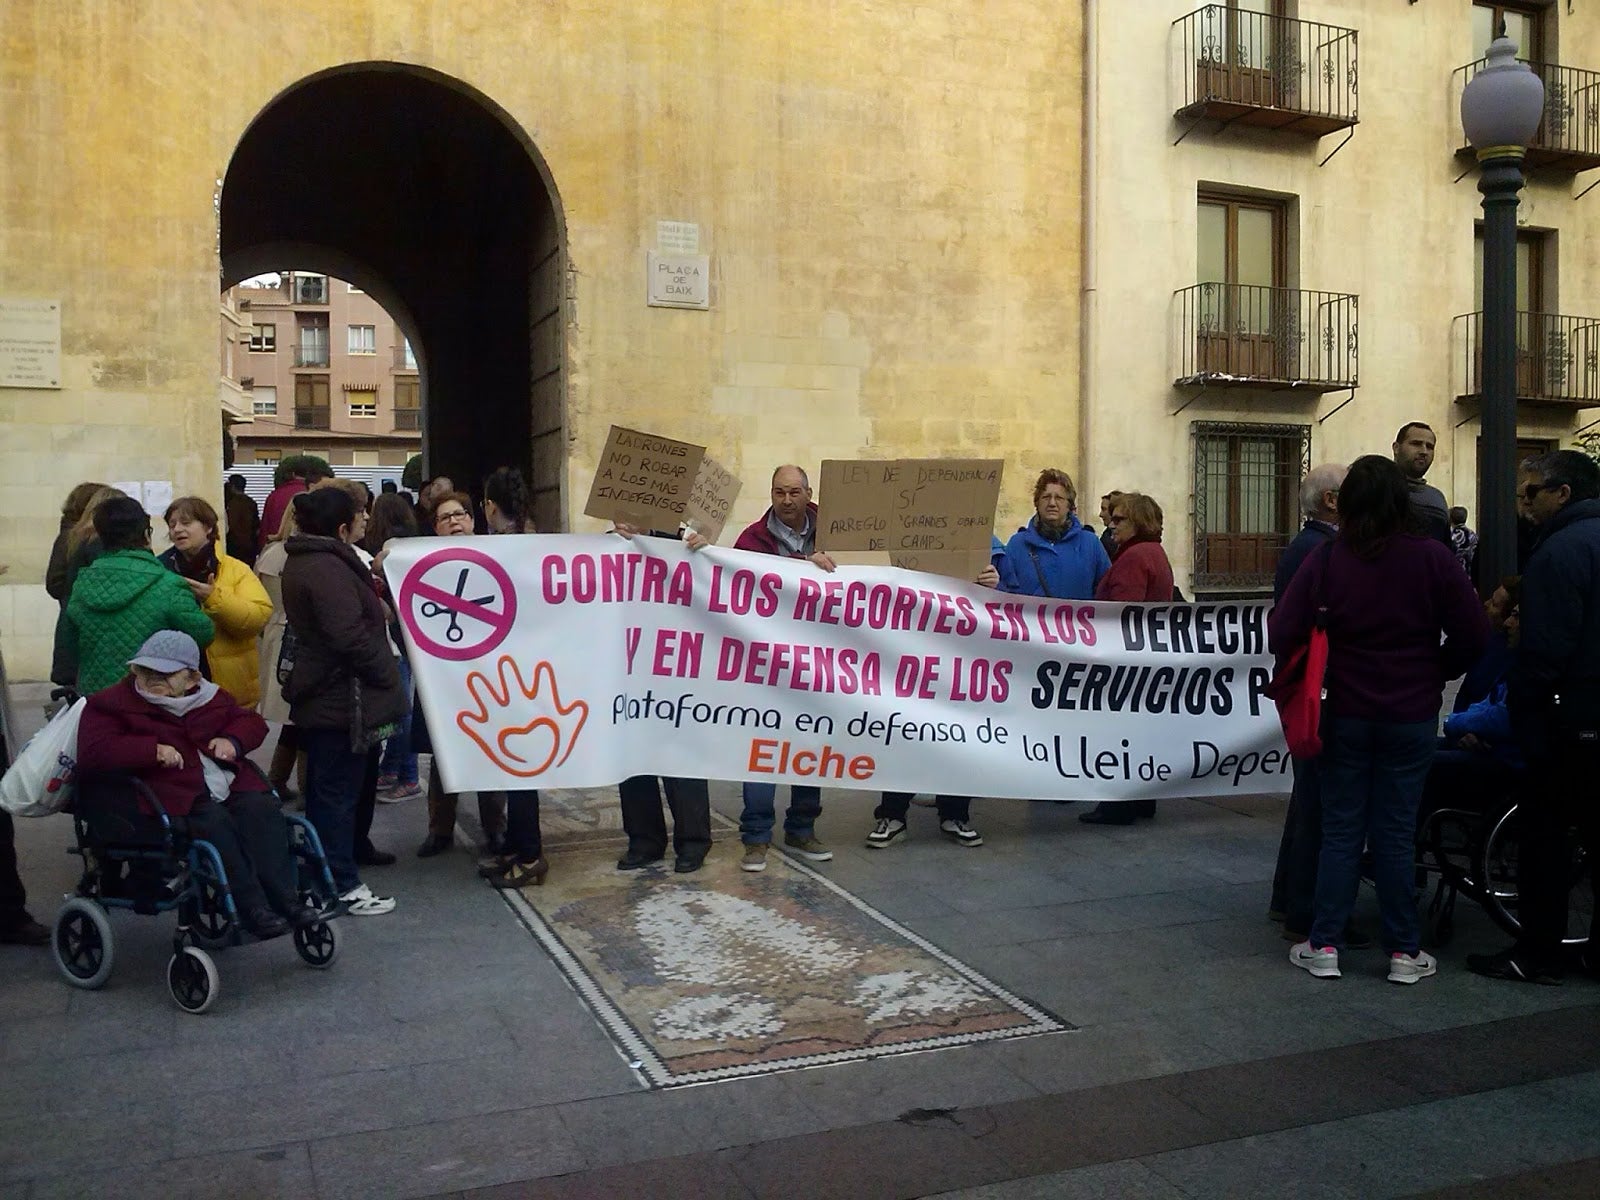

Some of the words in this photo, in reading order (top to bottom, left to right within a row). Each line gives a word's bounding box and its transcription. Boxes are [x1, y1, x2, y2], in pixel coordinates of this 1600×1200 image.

[665, 285, 693, 295] BAIX
[672, 276, 687, 284] DE
[616, 432, 688, 457] LADRONES
[609, 452, 631, 466] NO
[639, 457, 687, 479] ROBAR
[712, 468, 731, 486] NO
[842, 464, 870, 485] LEY
[883, 466, 900, 484] DE
[917, 465, 998, 484] DEPENDENCIA
[602, 469, 613, 480] A
[619, 471, 647, 486] LOS
[597, 486, 687, 513] INDEFENSOS
[830, 517, 887, 535] ARREGLO
[869, 538, 885, 551] DE
[900, 534, 945, 551] CAMPS
[541, 553, 694, 607] CONTRA
[708, 564, 783, 618] LOS
[793, 577, 978, 637] RECORTES
[984, 602, 1030, 642] EN
[1036, 603, 1098, 647] LOS
[1120, 604, 1274, 655] DERECH
[625, 626, 642, 675] Y
[652, 628, 705, 679] EN
[716, 636, 882, 697] DEFENSA
[895, 654, 941, 699] DE
[949, 656, 1013, 703] LOS
[1031, 660, 1235, 717] SERVICIOS
[1248, 667, 1274, 717] P
[795, 712, 834, 736] en
[846, 711, 967, 746] defensa
[976, 717, 1009, 744] de
[1022, 734, 1050, 763] la
[1053, 734, 1132, 781] Llei
[1137, 755, 1172, 782] de
[747, 738, 876, 781] Elche
